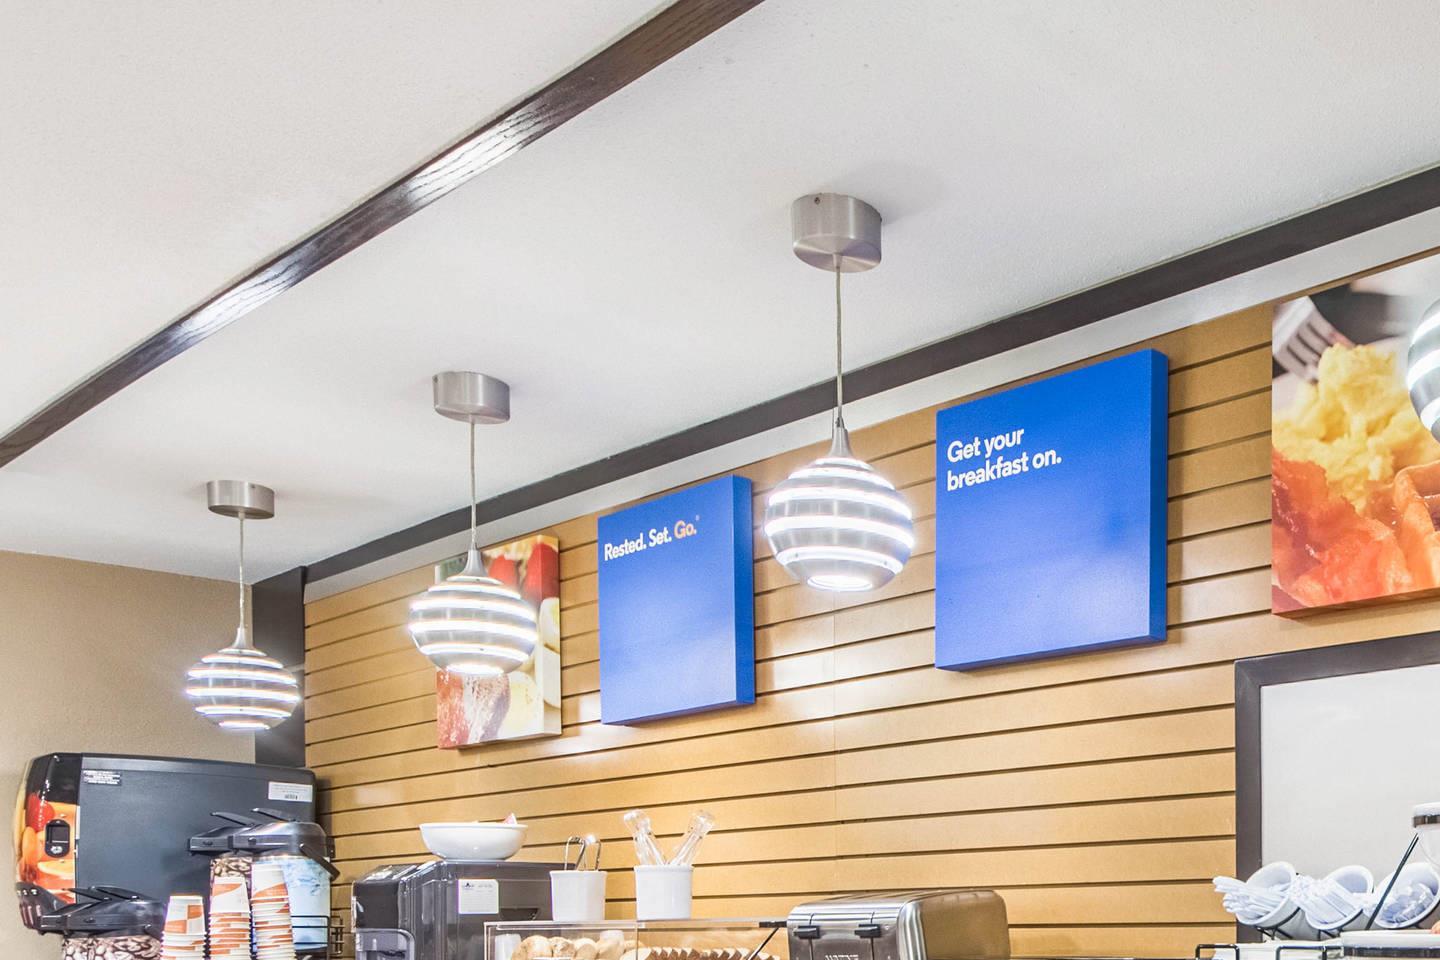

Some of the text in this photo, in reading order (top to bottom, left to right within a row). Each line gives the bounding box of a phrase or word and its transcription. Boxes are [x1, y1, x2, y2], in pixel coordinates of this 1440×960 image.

[947, 428, 1025, 463] Get your
[947, 449, 1063, 492] breakfast on.
[603, 519, 698, 561] Rested. Set. Go.
